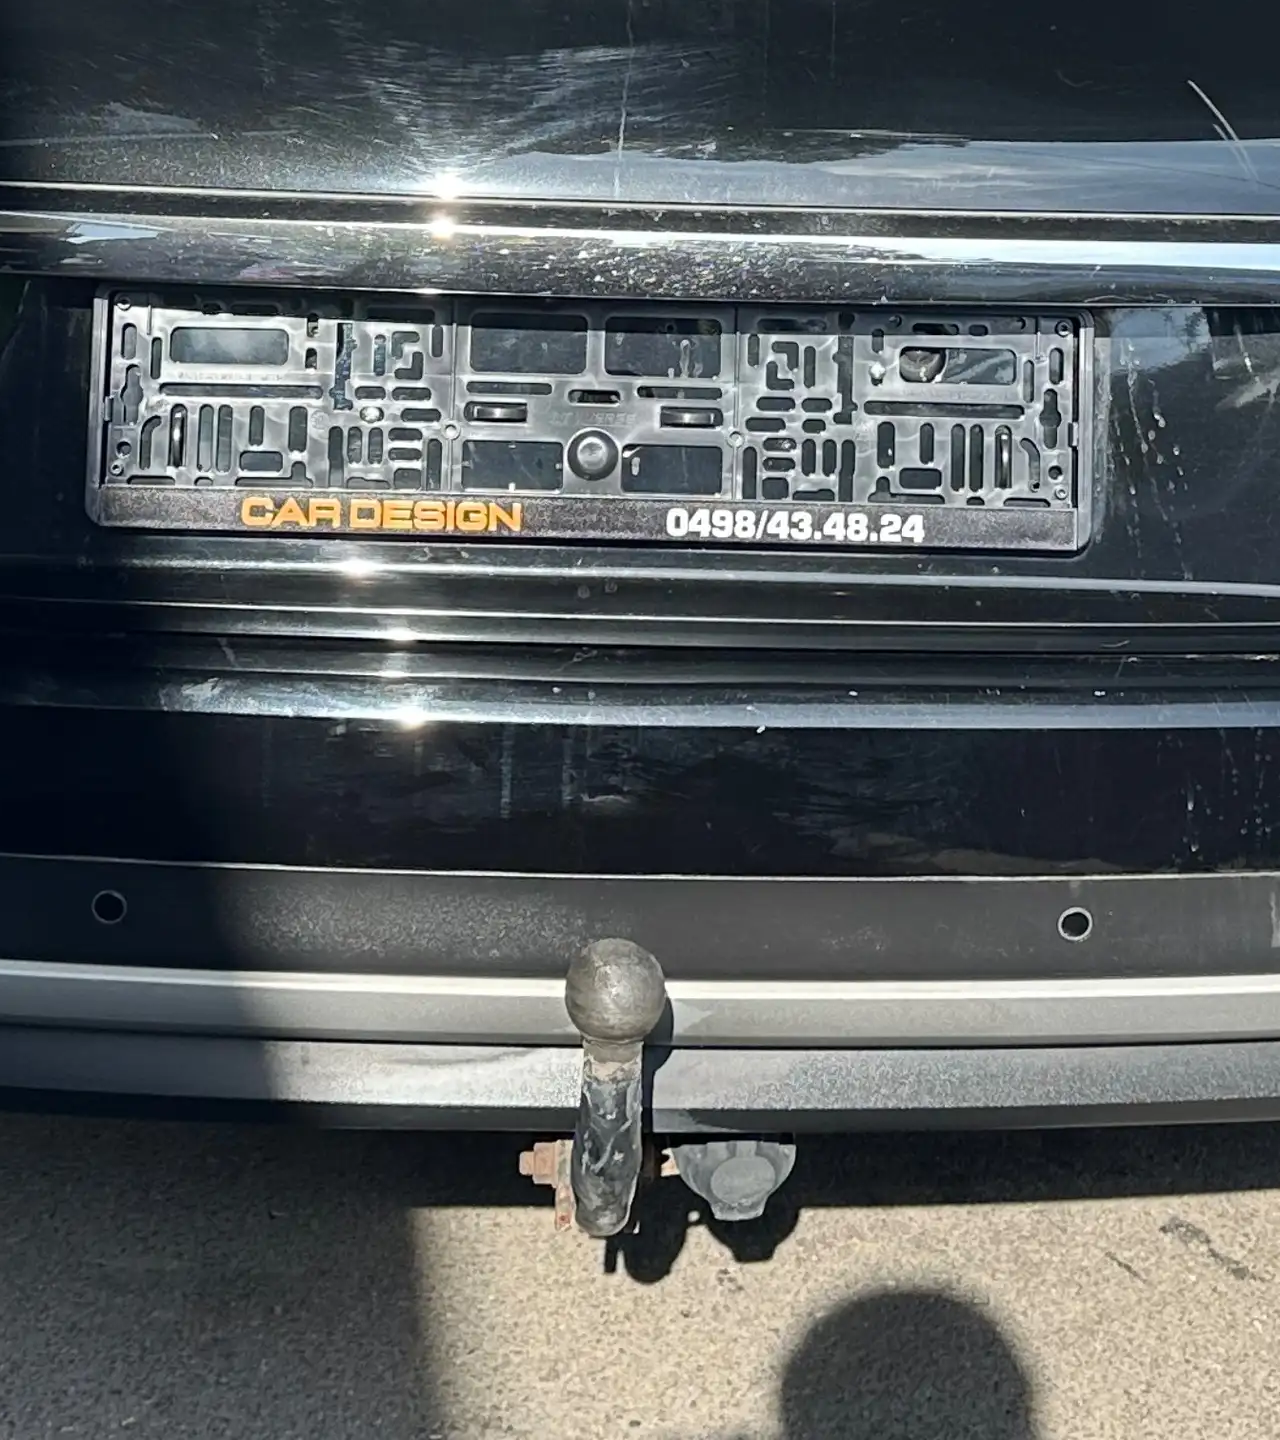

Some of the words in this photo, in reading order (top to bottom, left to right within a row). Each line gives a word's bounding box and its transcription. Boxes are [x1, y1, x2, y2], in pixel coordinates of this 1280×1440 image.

[240, 496, 341, 528] CAR
[348, 498, 522, 532] DESIGN
[665, 507, 926, 544] 0498/43.48.24
